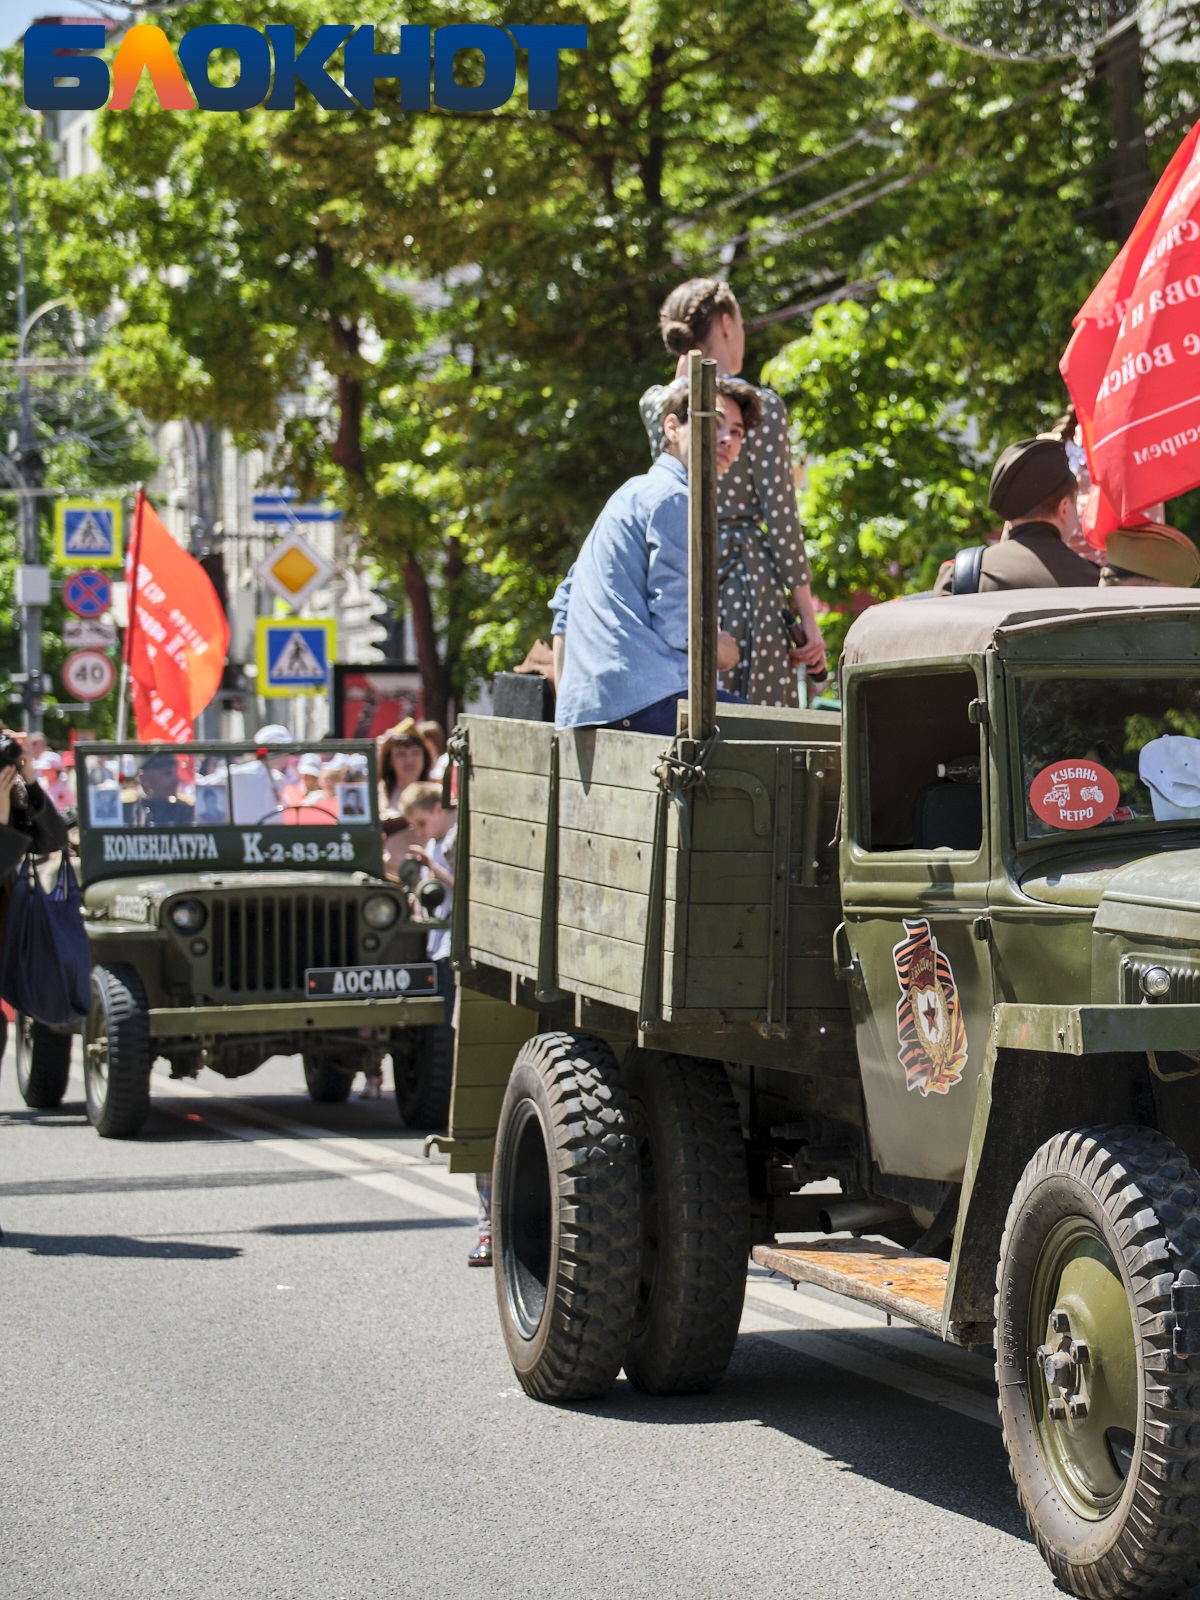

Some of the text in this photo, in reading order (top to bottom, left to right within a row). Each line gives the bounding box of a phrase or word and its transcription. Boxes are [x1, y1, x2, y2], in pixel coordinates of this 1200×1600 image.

[74, 663, 105, 684] 40
[1050, 767, 1099, 785] КУБАНЬ
[1059, 806, 1094, 822] РЕТРО
[102, 834, 219, 864] КОМЕНДАТУРА
[332, 973, 411, 994] ДОСААФ
